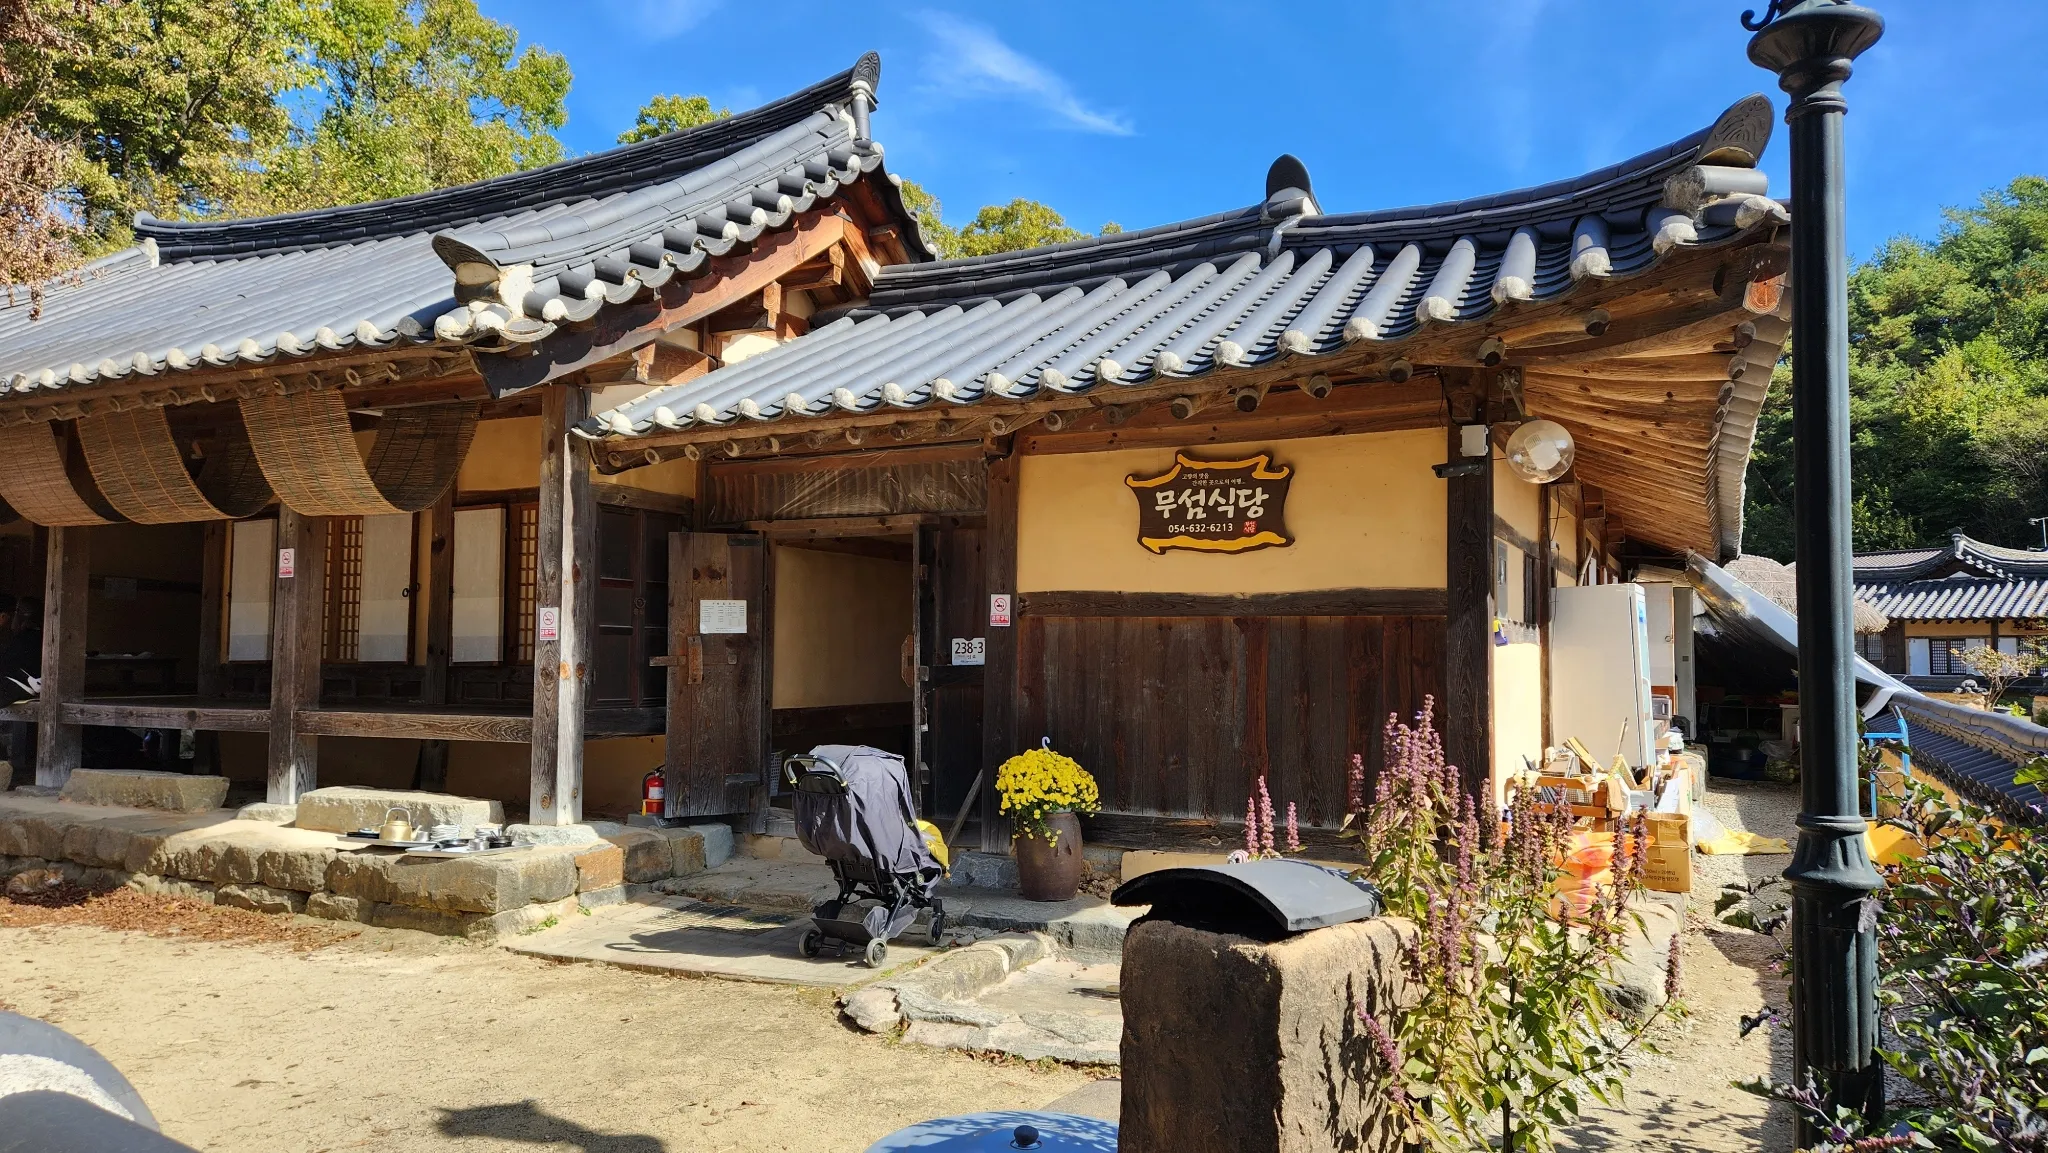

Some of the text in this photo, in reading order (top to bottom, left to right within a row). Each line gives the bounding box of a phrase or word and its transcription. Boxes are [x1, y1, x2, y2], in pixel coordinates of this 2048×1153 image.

[1155, 487, 1270, 520] 무섬식당
[1168, 522, 1233, 534] 054-632-6213
[955, 641, 983, 654] 238-3
